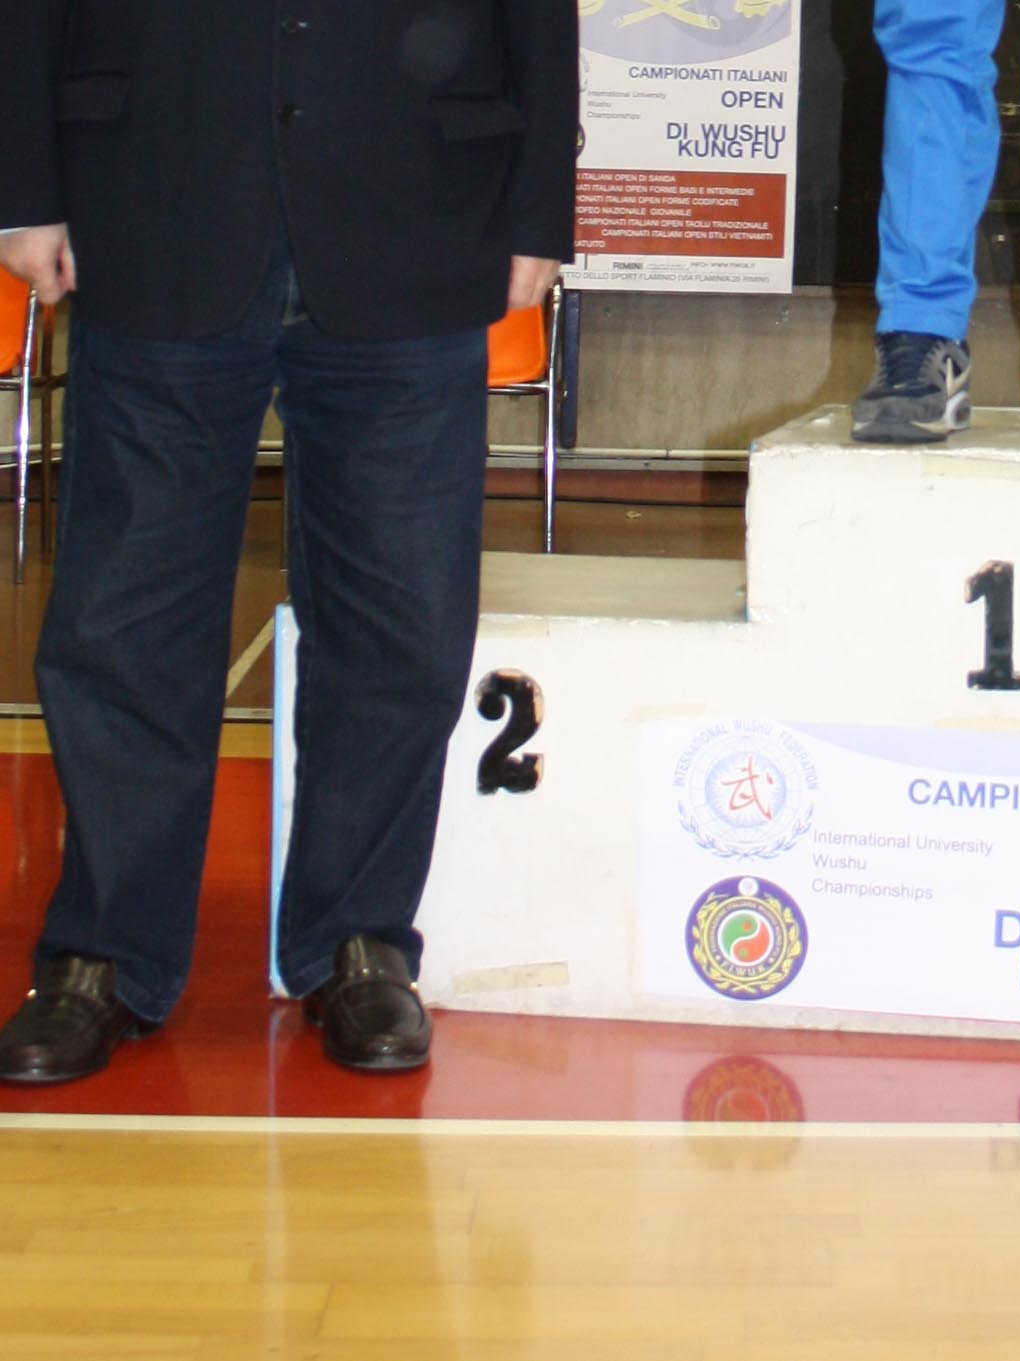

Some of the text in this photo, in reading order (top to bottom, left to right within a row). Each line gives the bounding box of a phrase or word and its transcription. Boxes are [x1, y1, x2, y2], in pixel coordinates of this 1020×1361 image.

[628, 66, 788, 83] CAMPIONATI ITALIANI
[721, 90, 784, 109] OPEN
[666, 122, 786, 142] DI WUSHU
[678, 140, 780, 159] KUNG FU
[475, 667, 545, 797] 2
[813, 829, 994, 857] International University
[812, 853, 867, 871] Wushu
[811, 878, 934, 903] Championships
